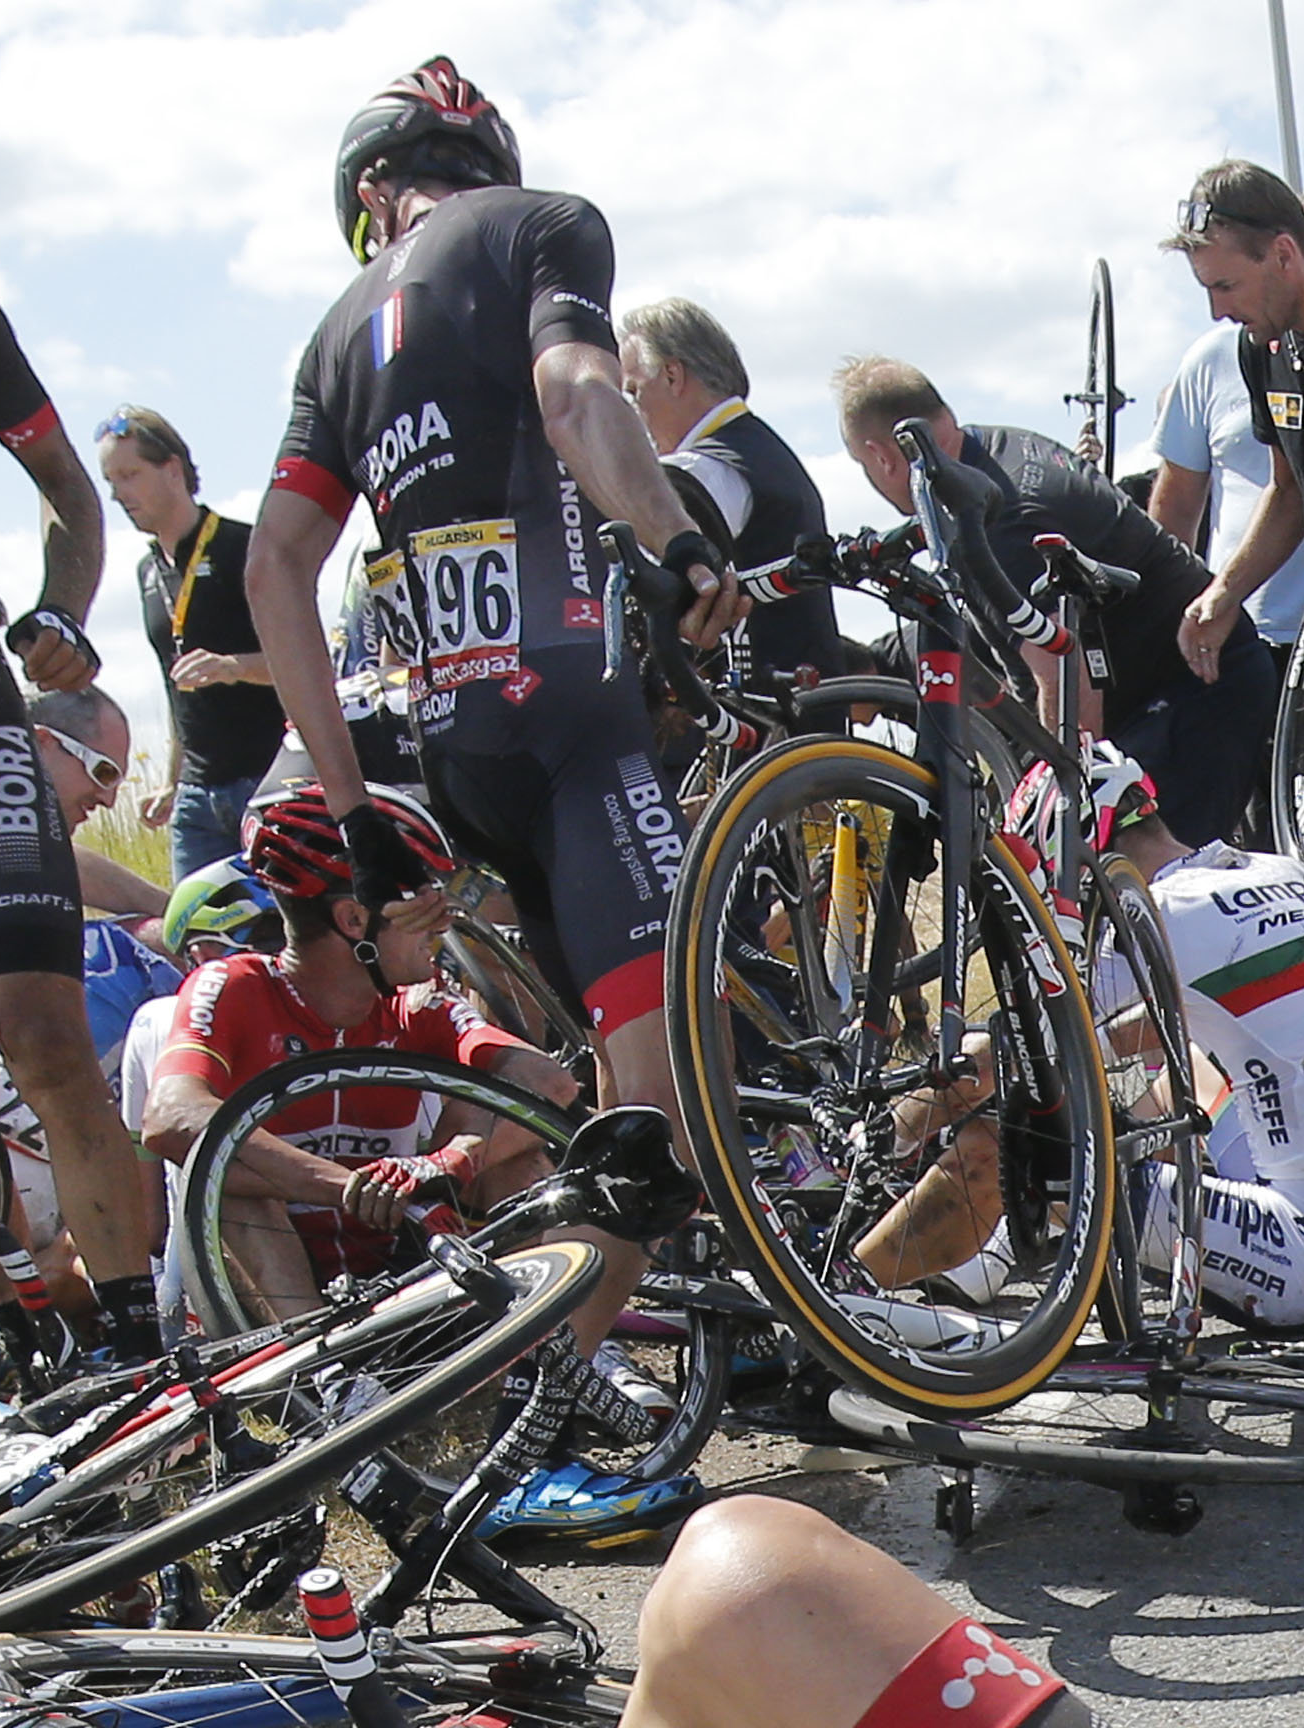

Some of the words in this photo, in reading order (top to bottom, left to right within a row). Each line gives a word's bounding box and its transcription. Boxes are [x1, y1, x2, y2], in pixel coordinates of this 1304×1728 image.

[365, 401, 452, 490] BORA
[427, 453, 455, 470] 18
[561, 480, 592, 595] ARGON
[432, 654, 519, 685] antargaz
[603, 792, 632, 847] cooking
[620, 847, 654, 902] systems
[625, 781, 684, 893] BORA
[1139, 1130, 1172, 1157] BORA
[1201, 1248, 1286, 1299] ERIDA
